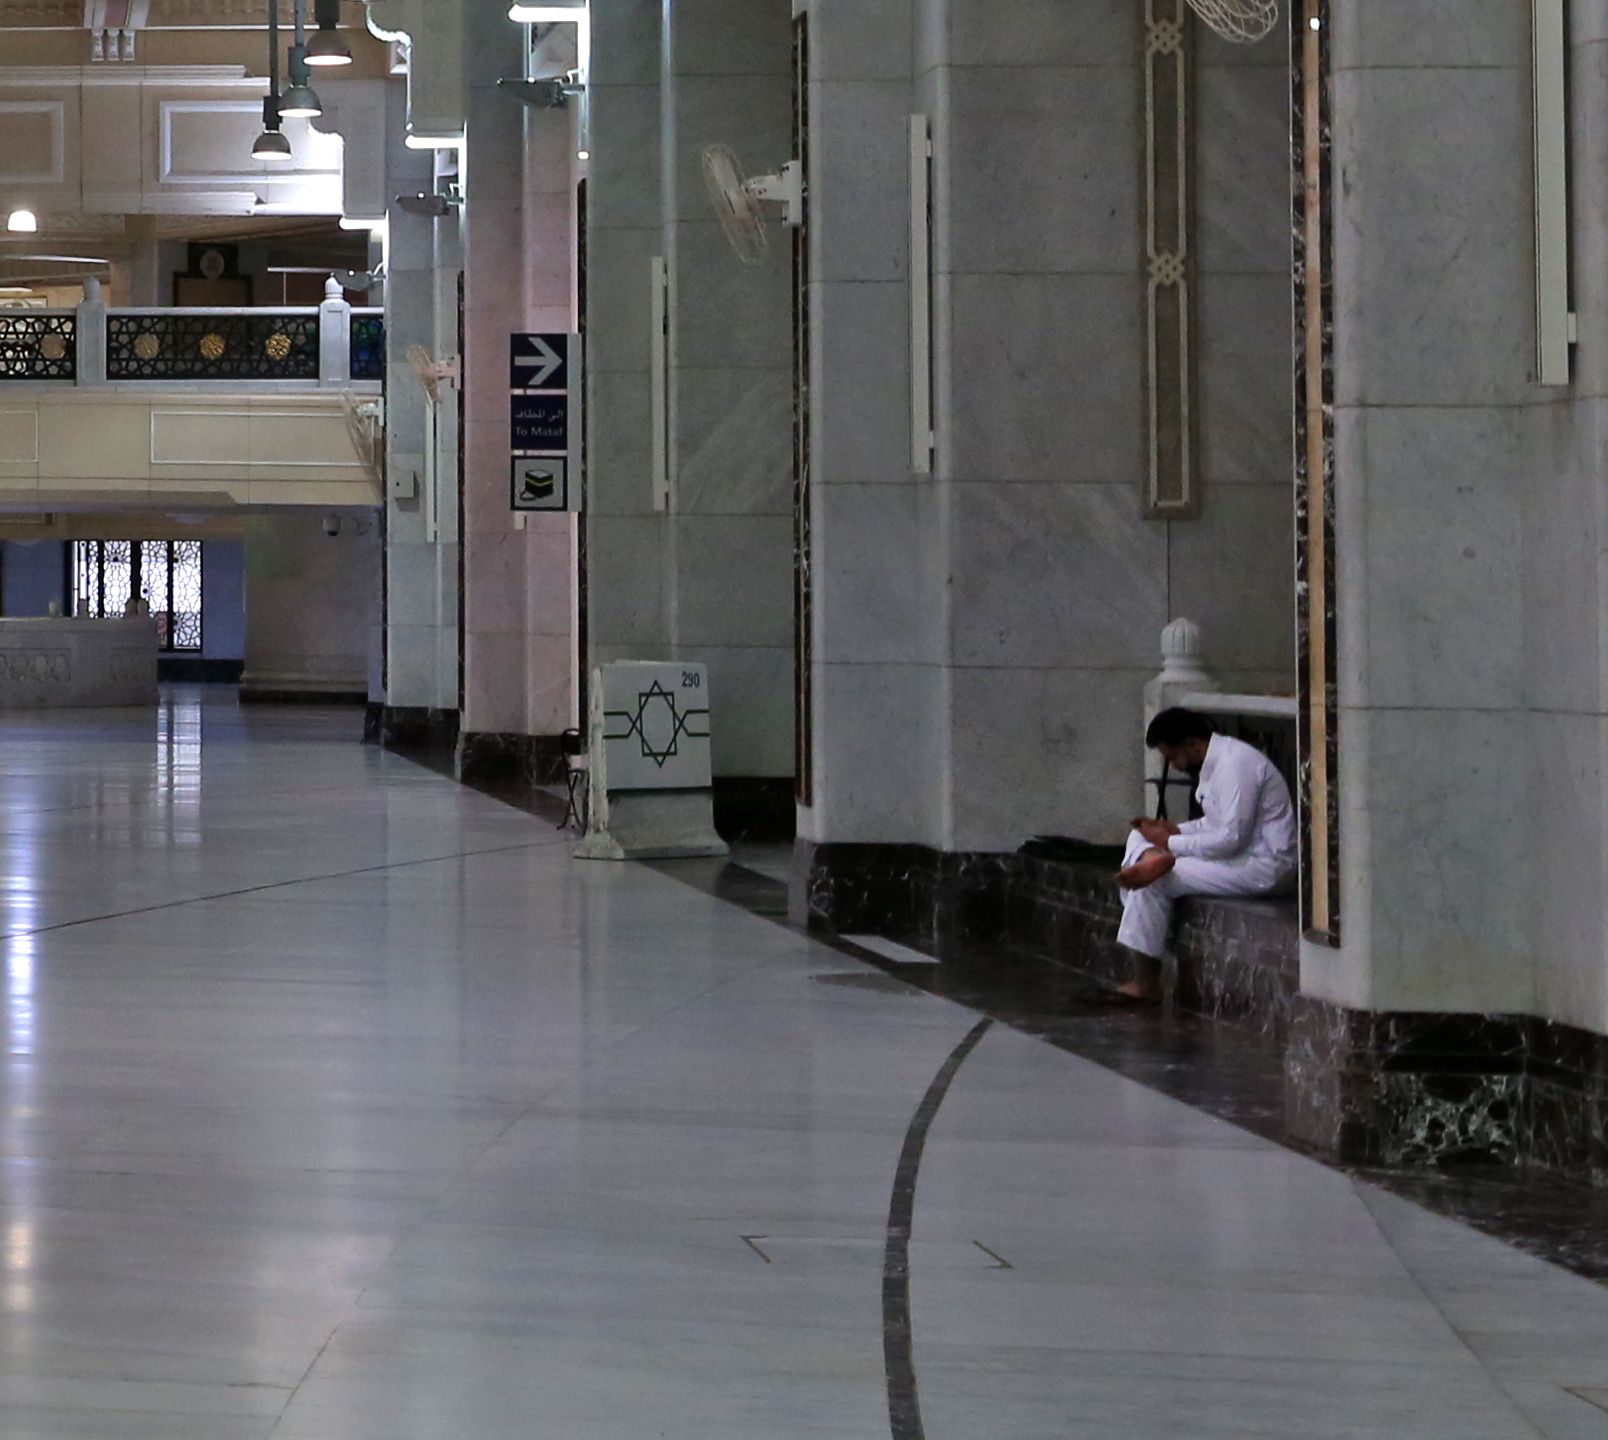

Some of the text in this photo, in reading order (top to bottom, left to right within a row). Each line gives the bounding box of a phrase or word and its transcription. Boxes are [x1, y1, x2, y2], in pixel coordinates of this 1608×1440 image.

[514, 409, 546, 419] المطاف
[515, 426, 564, 437] To Mataf
[681, 670, 700, 688] 290
